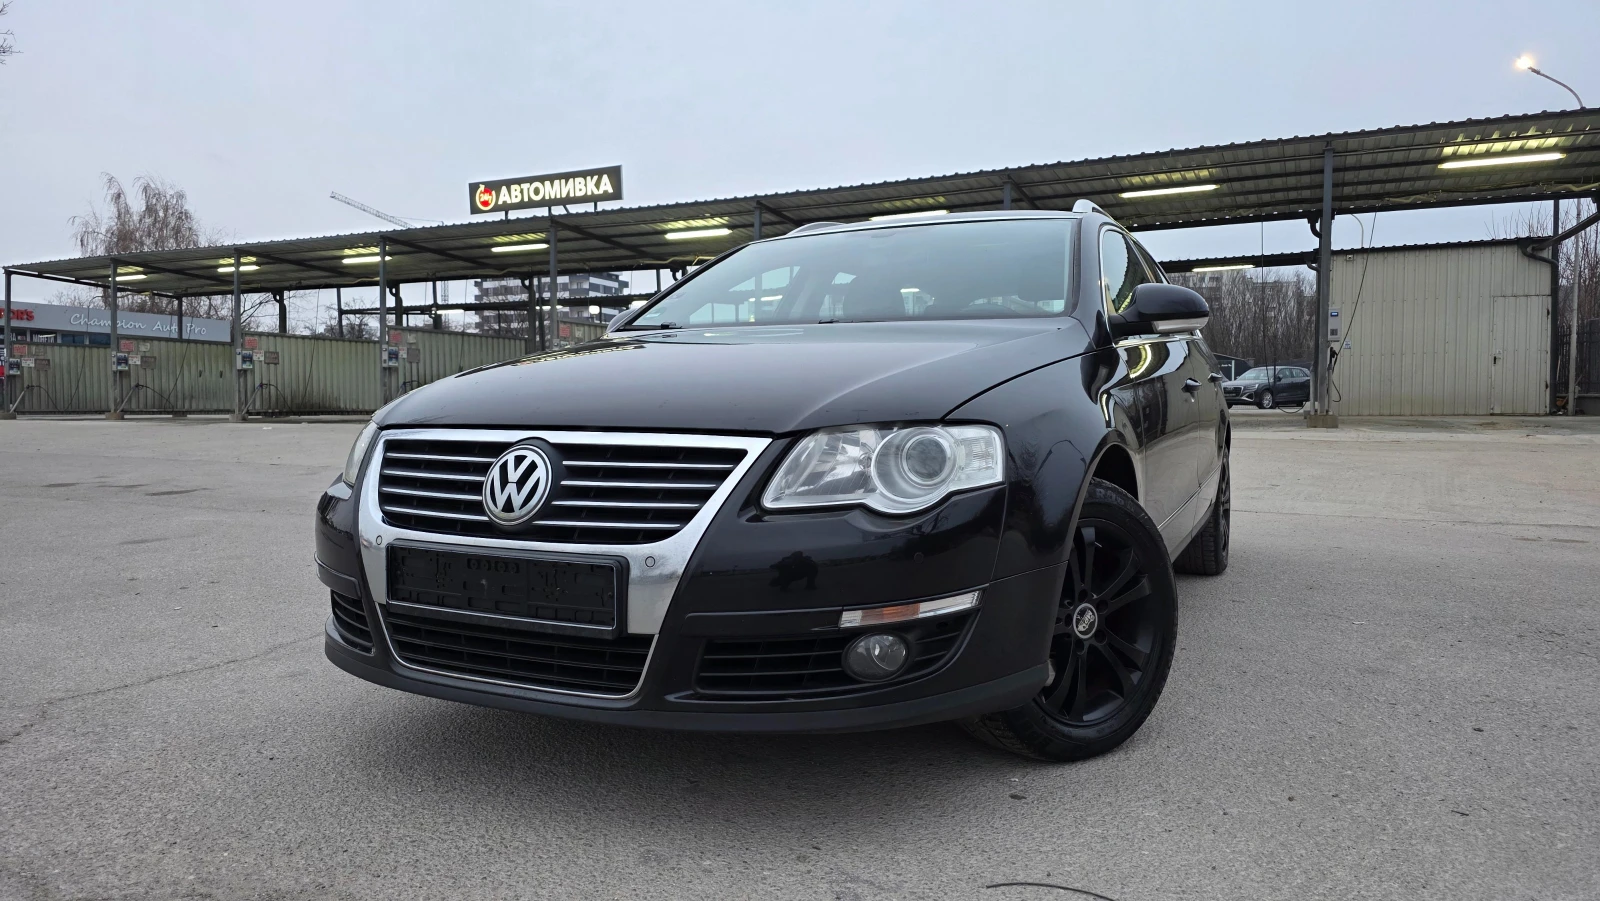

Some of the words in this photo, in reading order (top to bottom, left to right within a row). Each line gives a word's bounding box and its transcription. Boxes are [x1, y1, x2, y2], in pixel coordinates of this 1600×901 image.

[498, 173, 614, 205] АВТОМИВКА
[152, 320, 182, 333] Aut
[186, 323, 207, 335] Pro
[484, 448, 548, 520] VW
